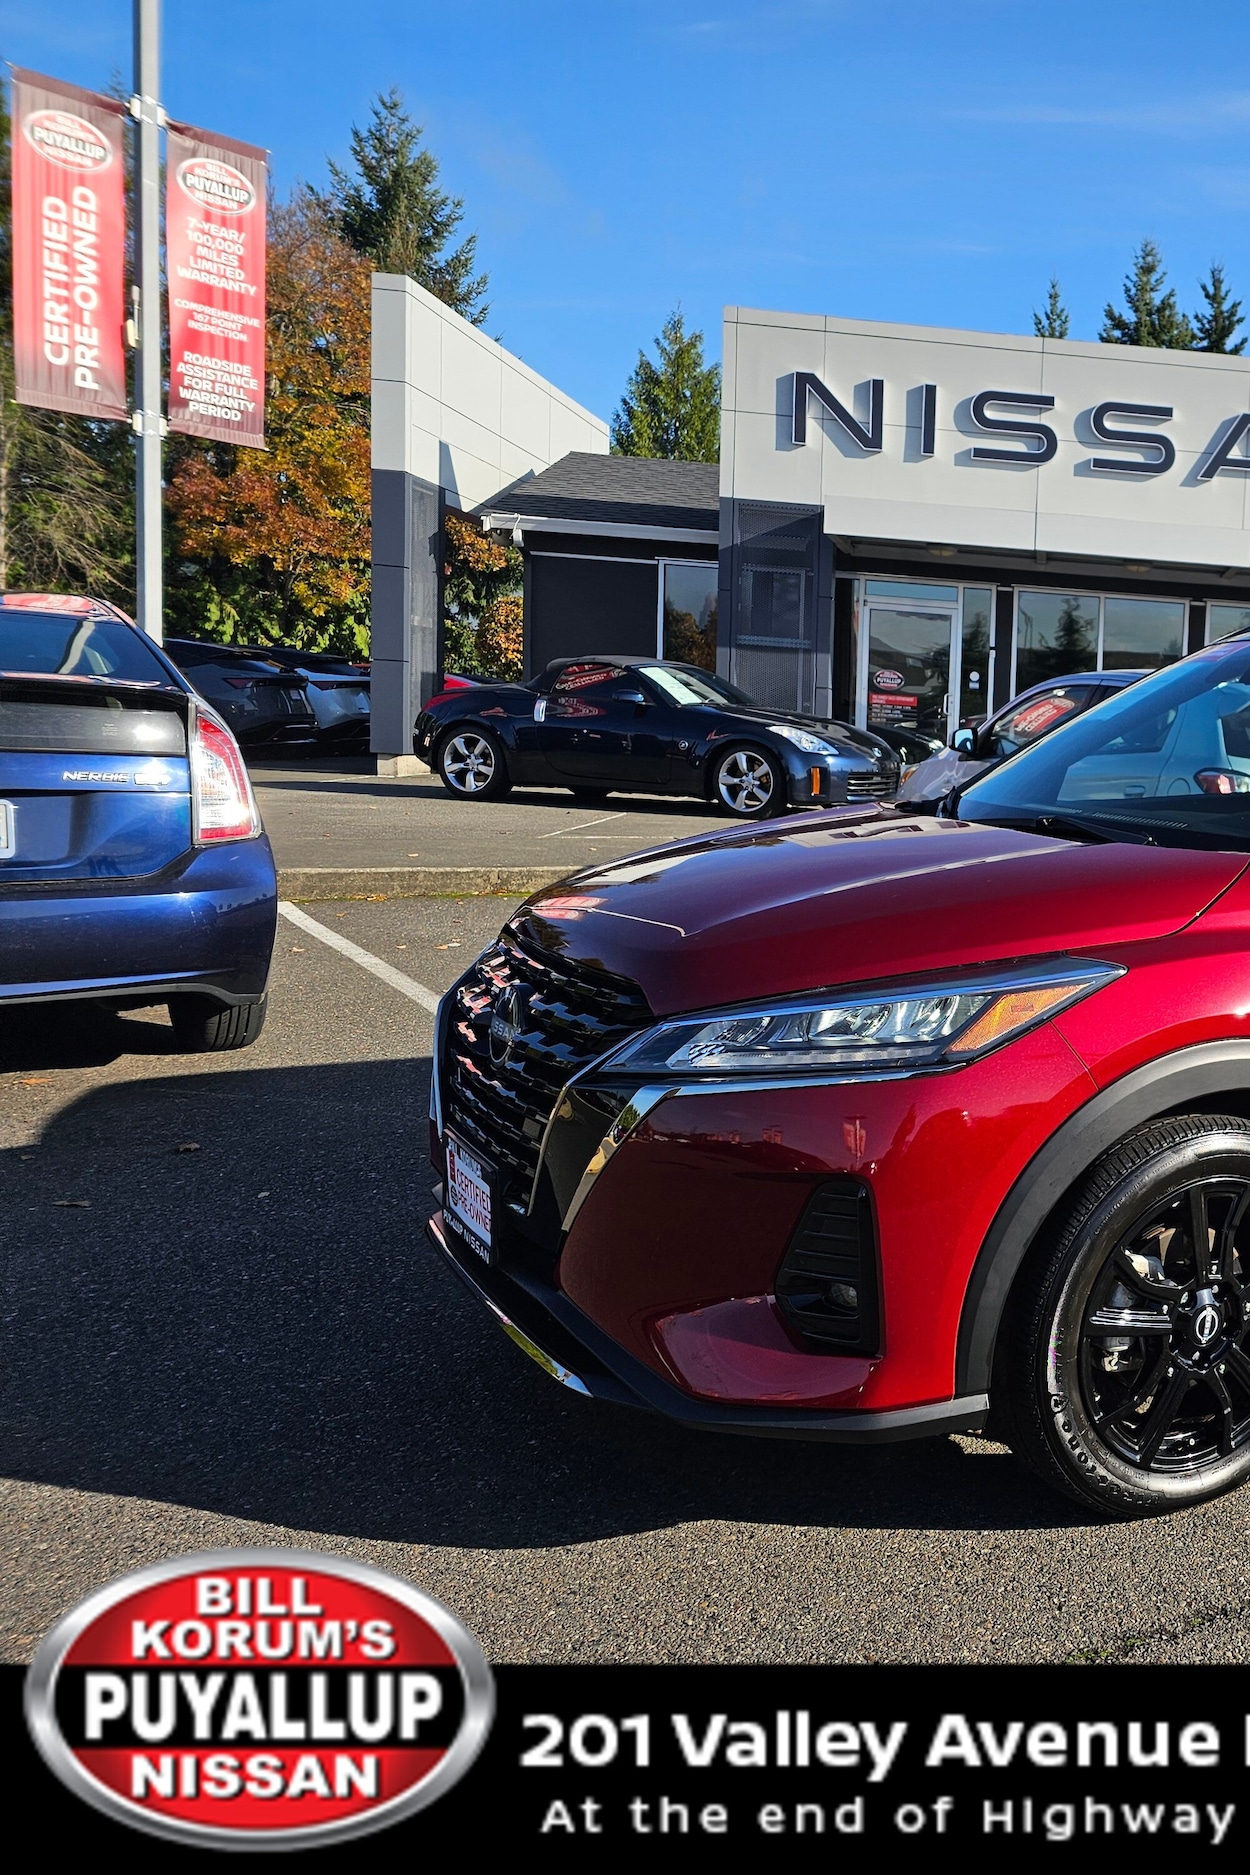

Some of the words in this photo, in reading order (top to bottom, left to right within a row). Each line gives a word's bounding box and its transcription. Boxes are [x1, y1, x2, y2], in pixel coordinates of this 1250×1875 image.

[32, 125, 106, 161] PUYALLUP
[185, 173, 250, 203] PUYALLUP
[194, 190, 239, 210] NISSAN
[186, 229, 244, 255] 100,000
[189, 256, 245, 282] LIMITED
[196, 245, 240, 267] MILES
[43, 195, 69, 366] CERTIFIED
[73, 185, 100, 390] PRE-OWNED
[176, 265, 257, 297] WARRANTY
[173, 298, 260, 329] COMPREHENSIVE
[211, 315, 243, 332] POINT
[187, 319, 248, 343] INSPECTION
[176, 362, 259, 390] ASSISTANCE
[183, 351, 252, 377] ROADSIDE
[178, 386, 256, 413] WARRANTY
[183, 376, 213, 392] FOR
[214, 382, 248, 400] FULL
[188, 401, 242, 422] PERIOD
[456, 1167, 491, 1213] CERTIFIED
[457, 1191, 491, 1233] PRE-OWNE
[463, 1230, 490, 1265] NISSAN
